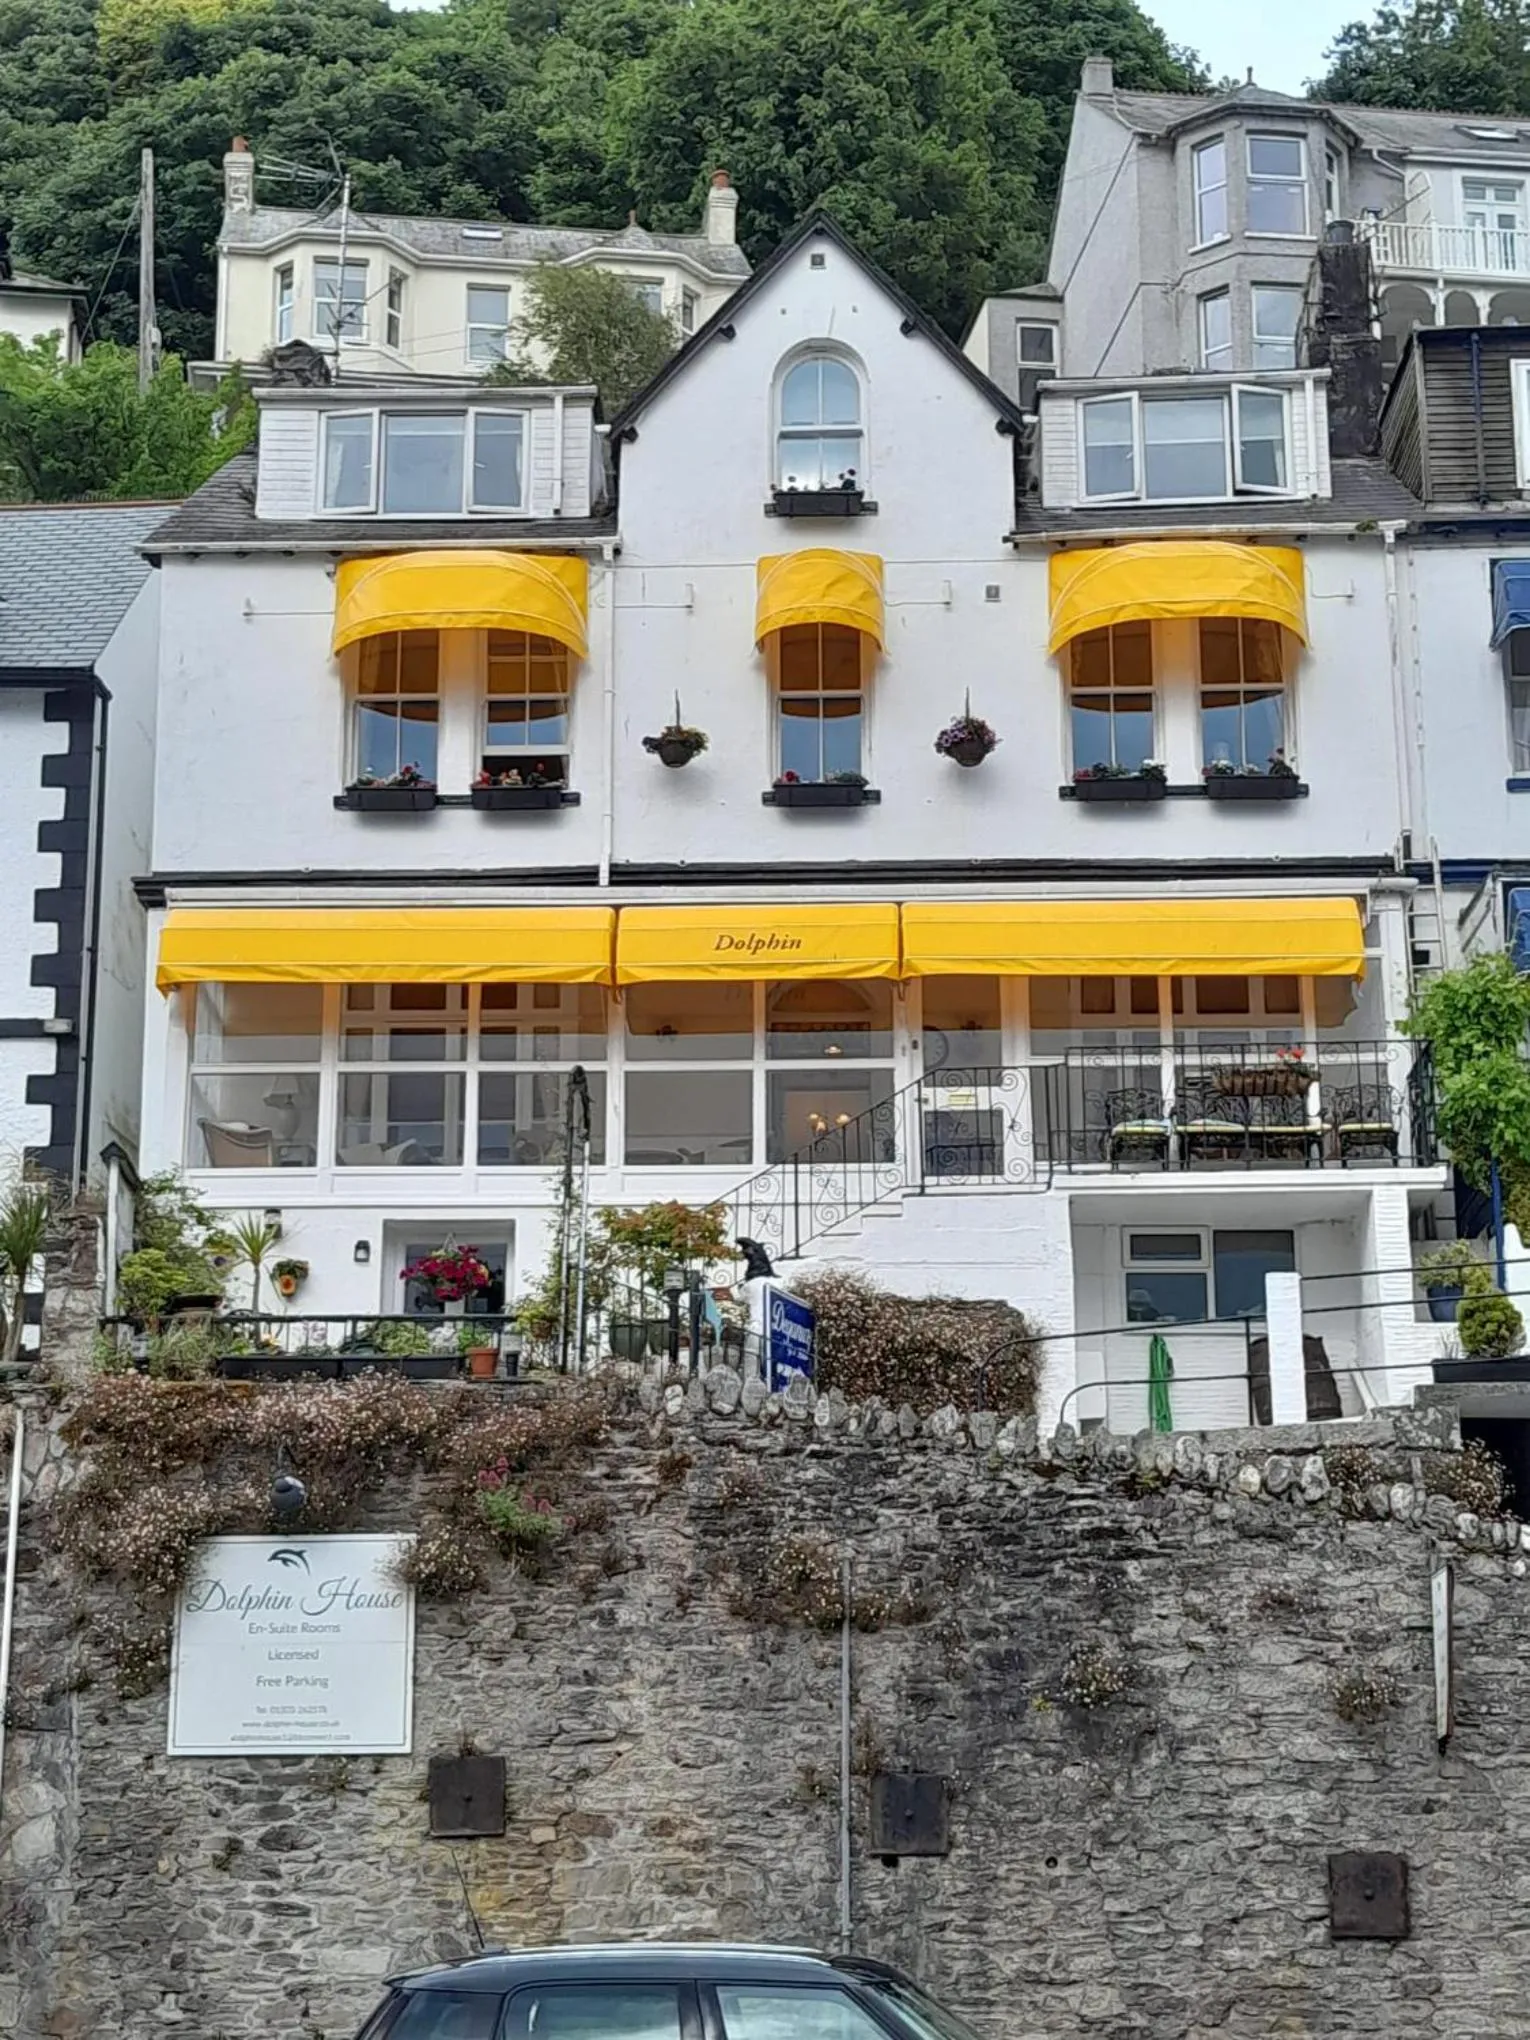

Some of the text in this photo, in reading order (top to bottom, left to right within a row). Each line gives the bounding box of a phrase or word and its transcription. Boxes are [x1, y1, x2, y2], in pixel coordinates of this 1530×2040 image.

[715, 932, 802, 956] Dolphin
[186, 1576, 403, 1620] Dolphin House
[248, 1621, 341, 1634] En-Suite Rooms
[268, 1648, 319, 1660] Licensed
[256, 1675, 329, 1688] Free Parking
